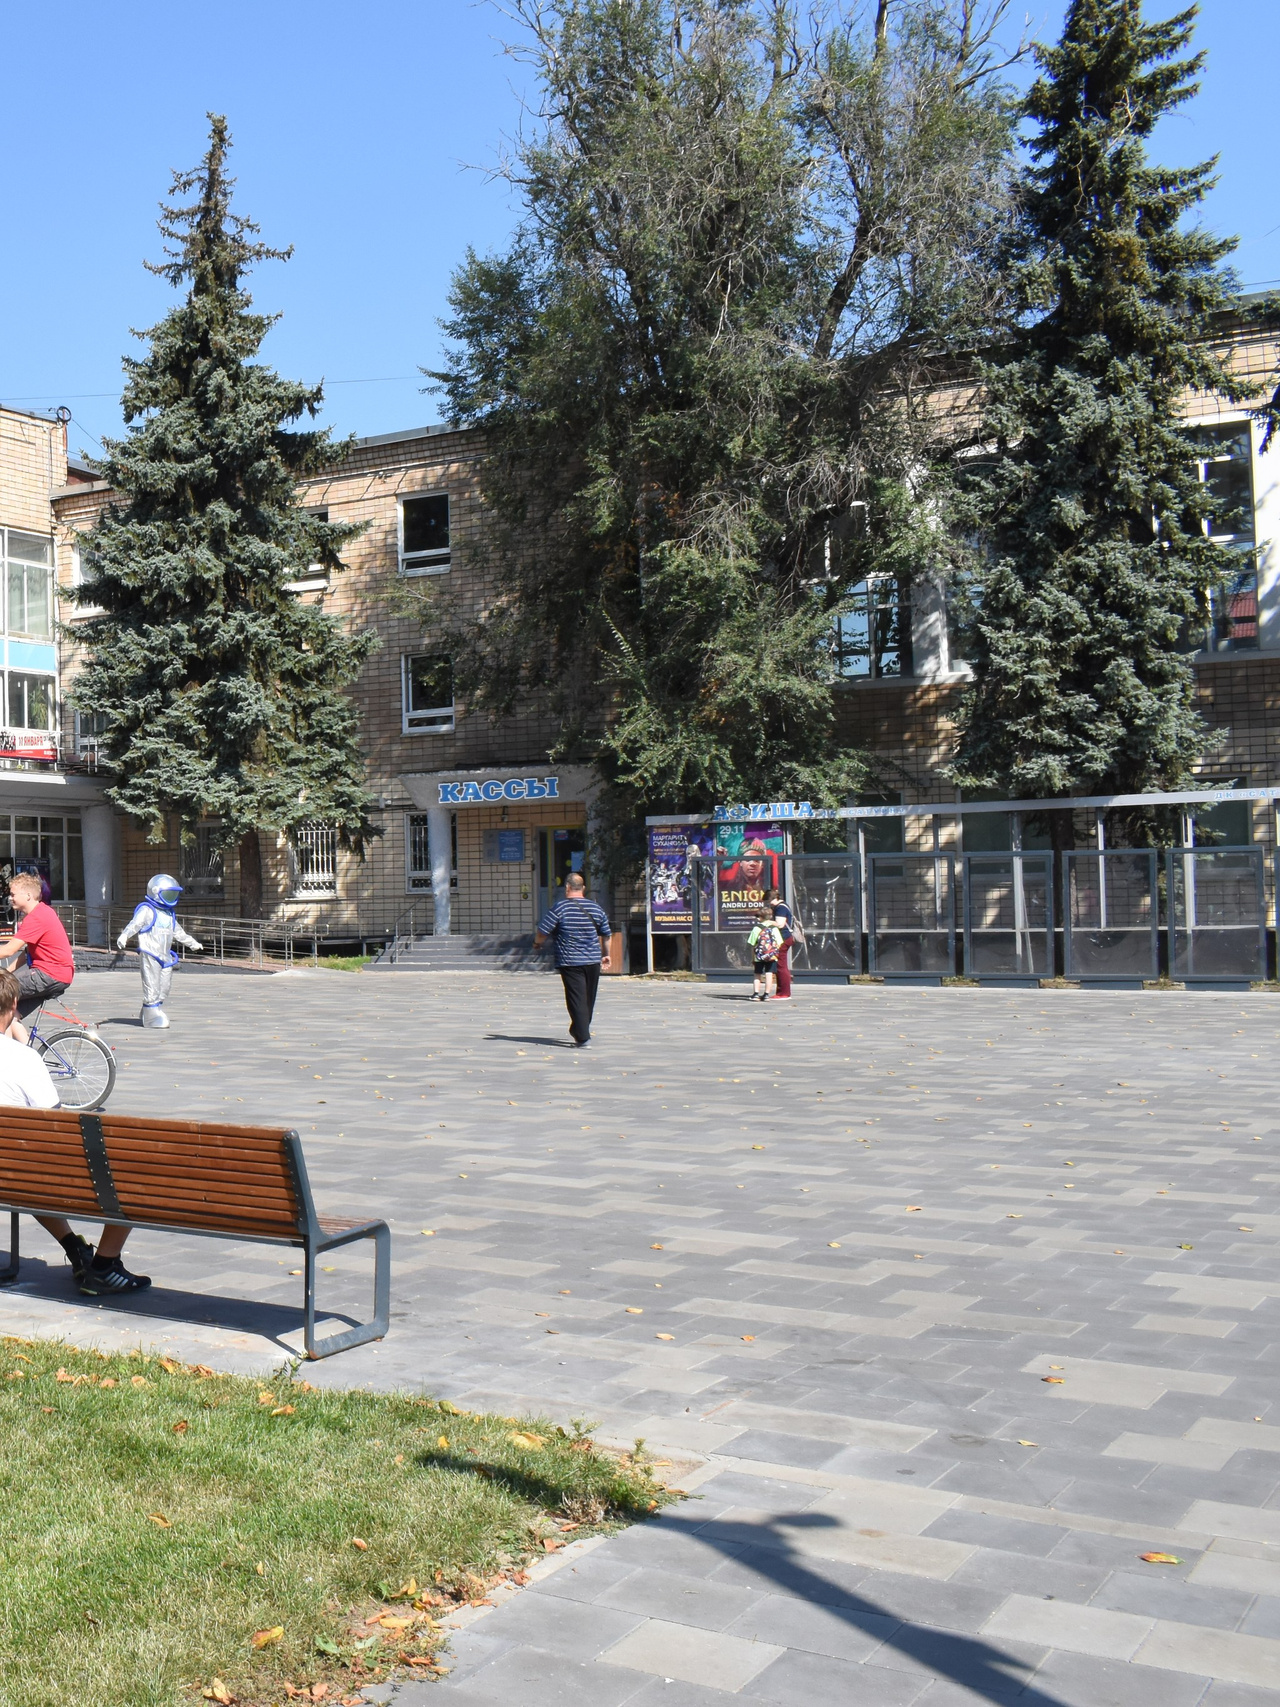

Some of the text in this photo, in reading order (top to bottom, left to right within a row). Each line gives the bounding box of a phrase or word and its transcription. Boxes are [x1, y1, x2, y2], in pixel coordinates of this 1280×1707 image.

[24, 735, 44, 746] ЯНВАРЯ
[438, 776, 559, 804] КАССЫ
[1214, 789, 1278, 799] ДК «САТ
[712, 801, 816, 821] АФИША
[719, 825, 745, 835] 29.11
